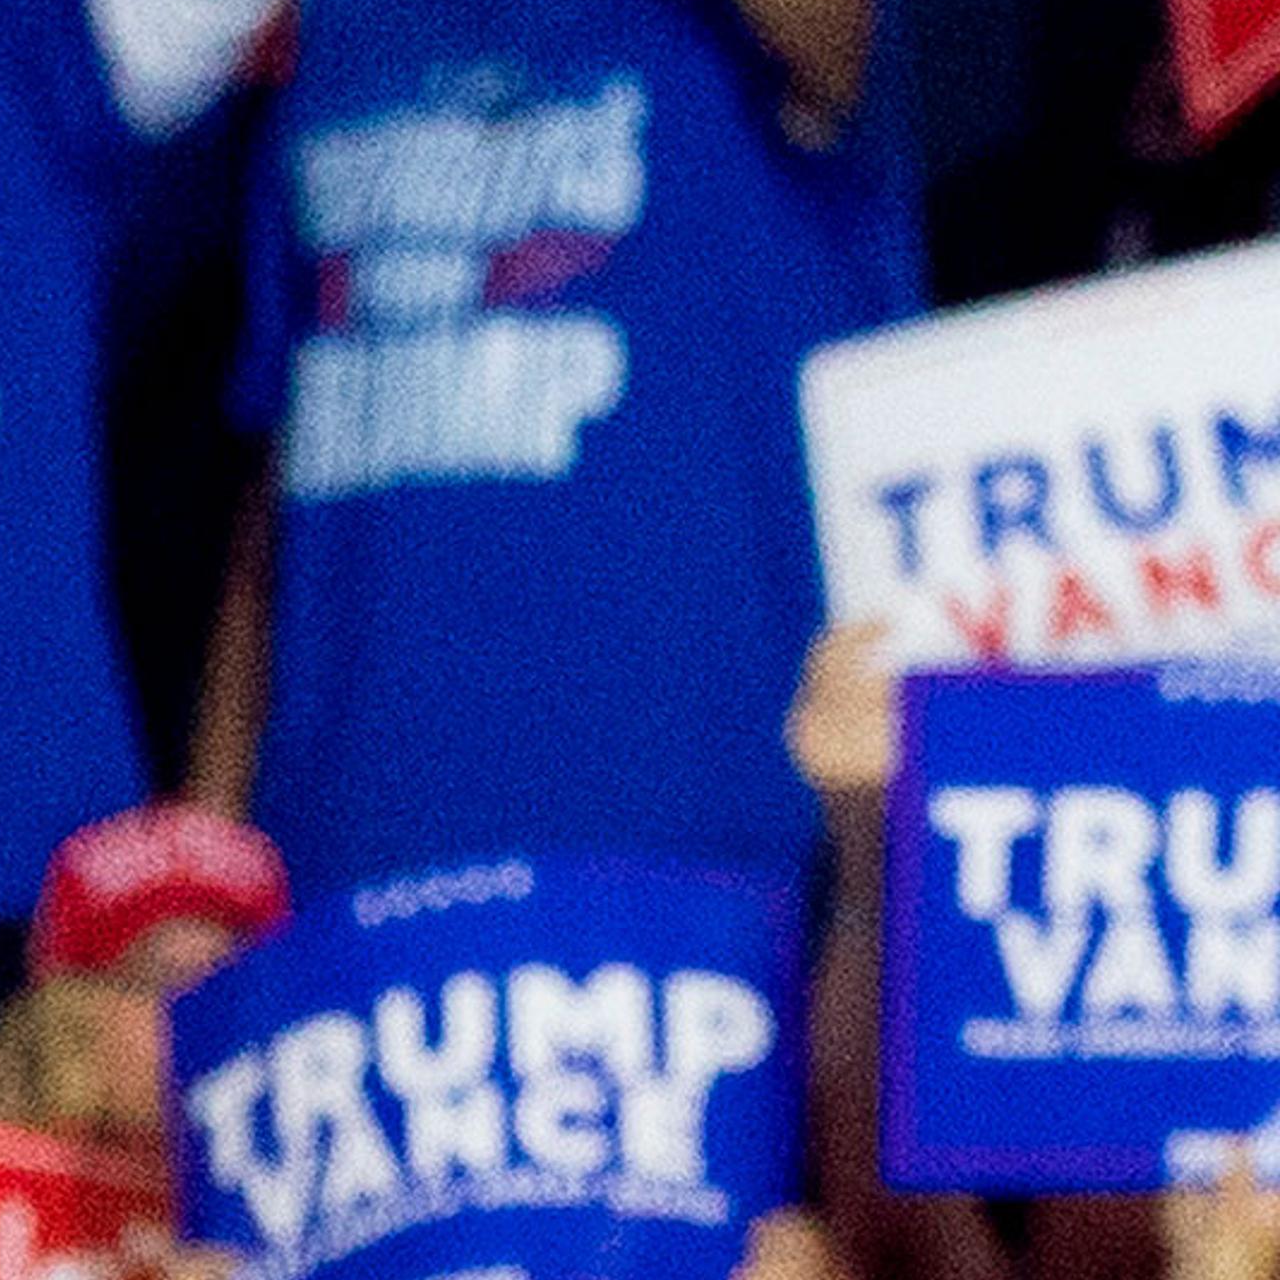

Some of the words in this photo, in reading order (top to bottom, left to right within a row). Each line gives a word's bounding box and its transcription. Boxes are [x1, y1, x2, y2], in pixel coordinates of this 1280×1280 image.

[943, 517, 1280, 665] VANC
[928, 785, 1280, 922] TRU
[992, 910, 1280, 1022] VAN
[185, 960, 775, 1190] TRUMP
[242, 1080, 708, 1265] VANCE
